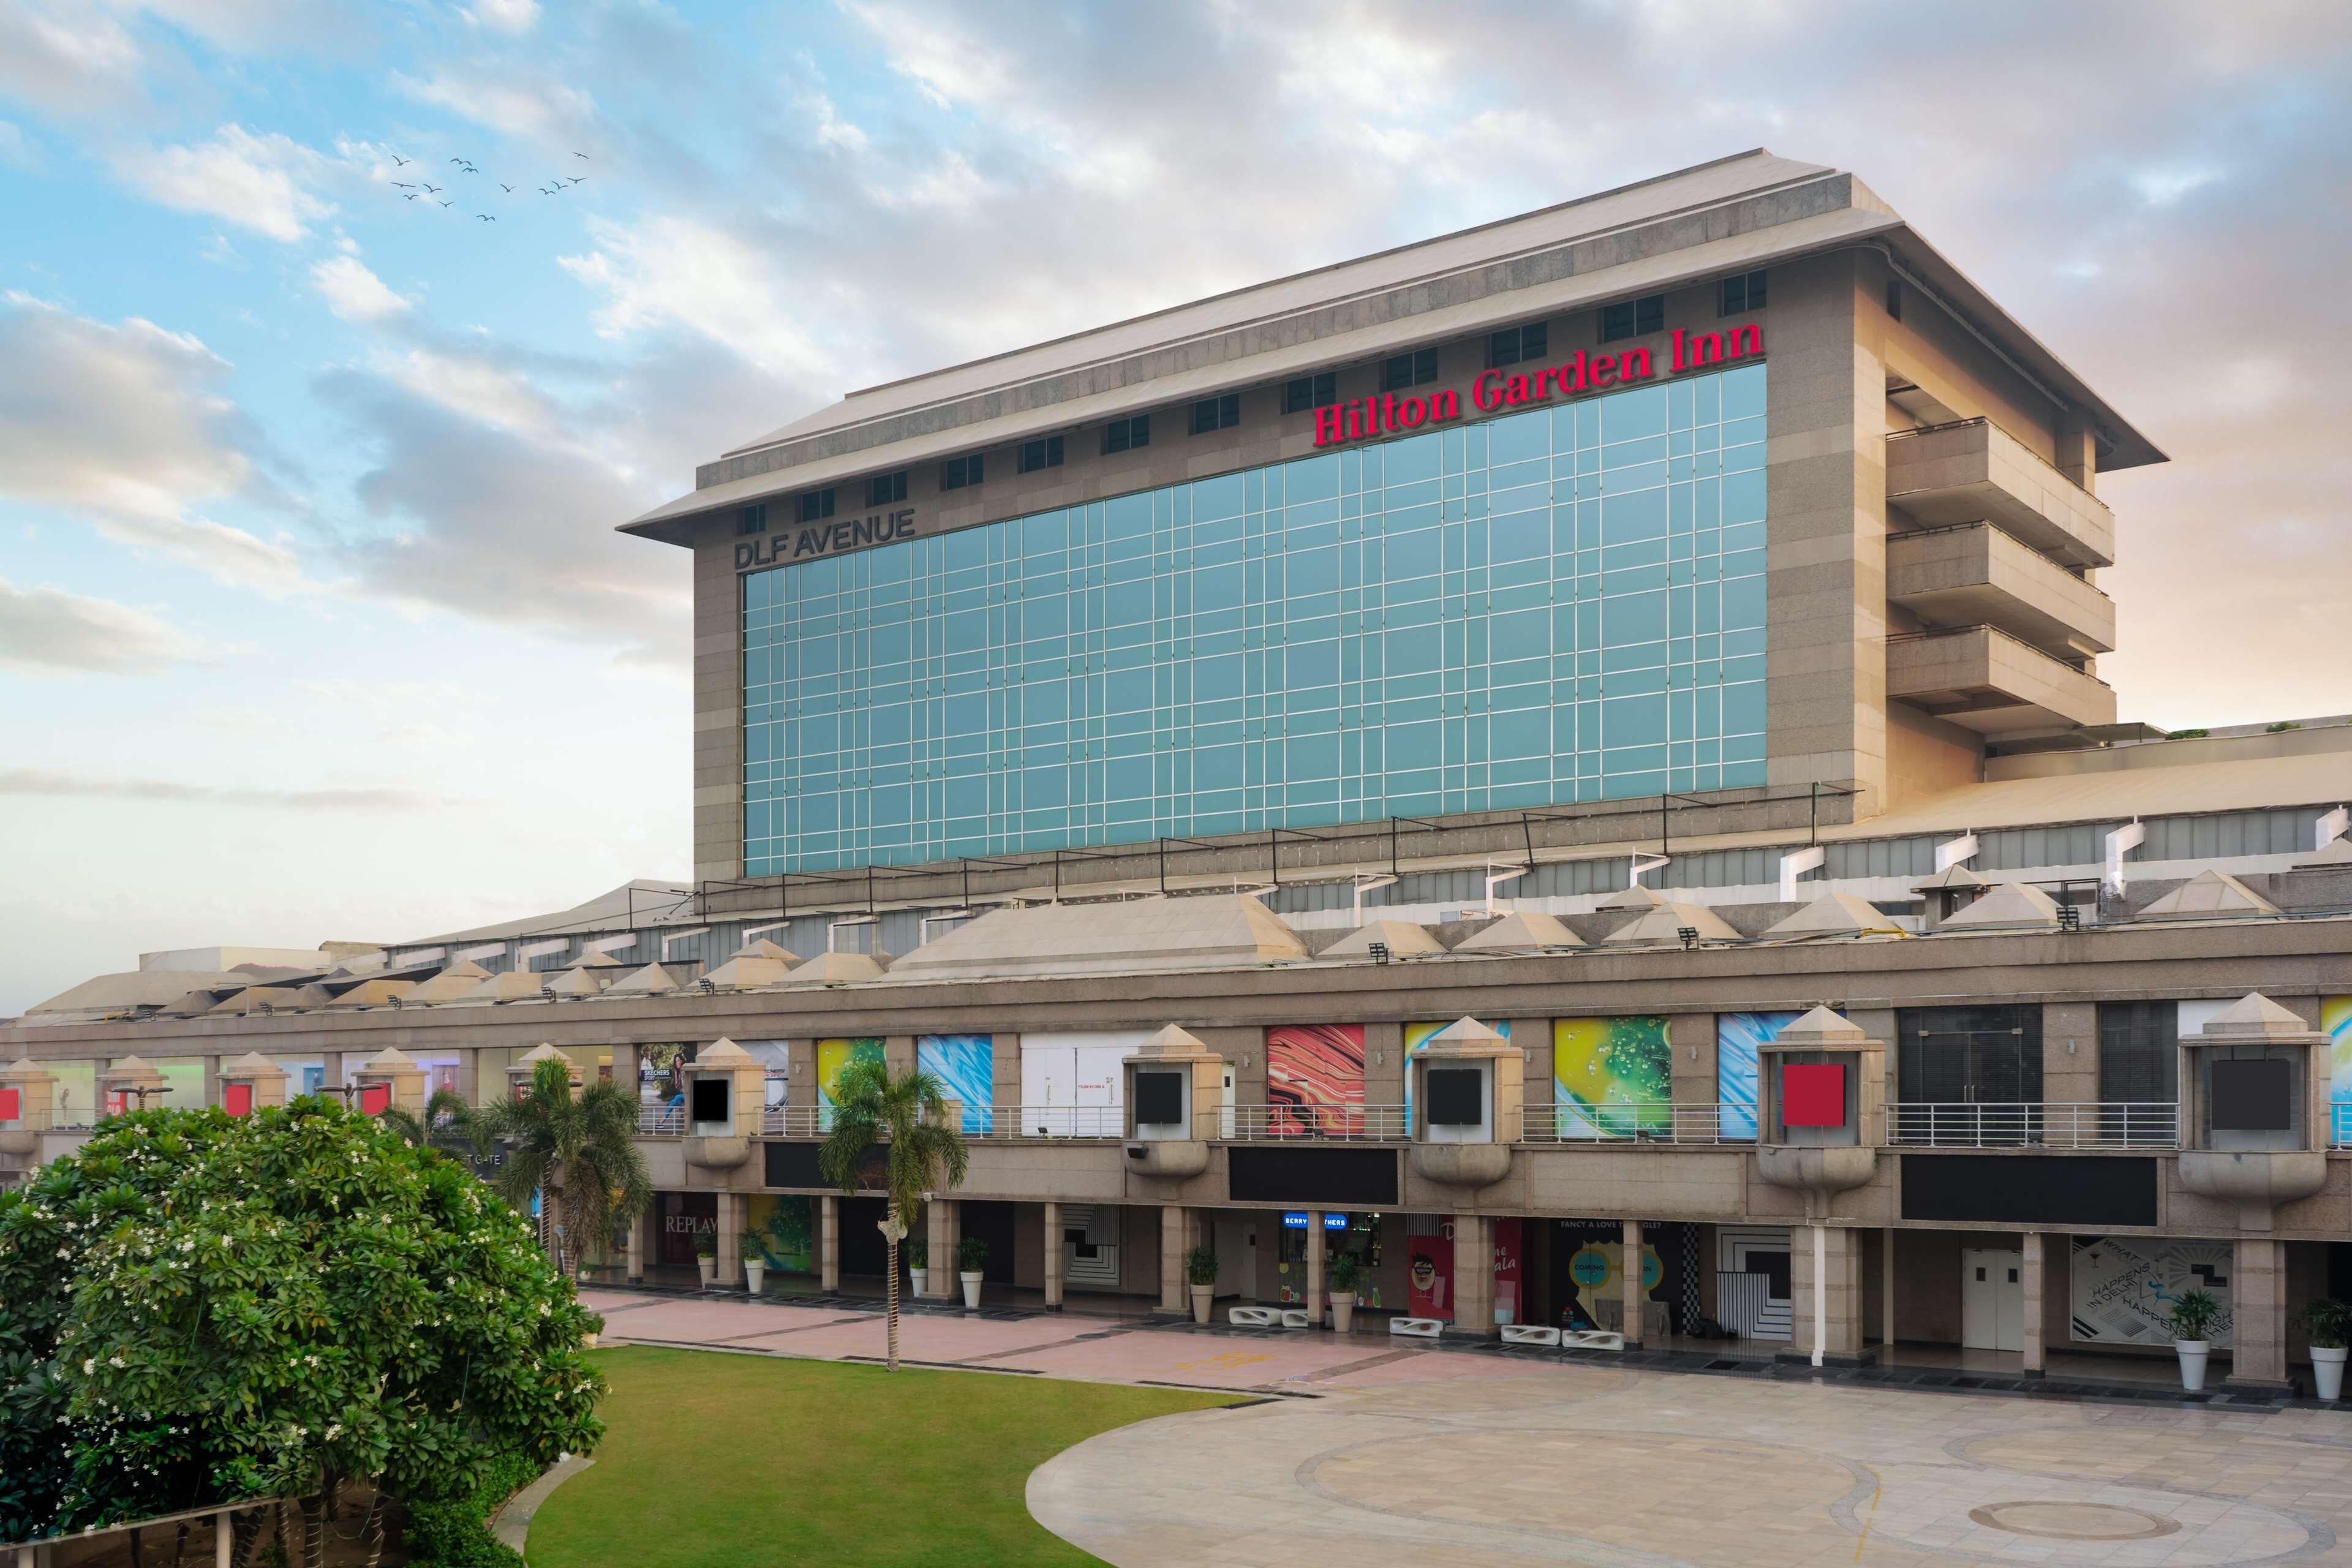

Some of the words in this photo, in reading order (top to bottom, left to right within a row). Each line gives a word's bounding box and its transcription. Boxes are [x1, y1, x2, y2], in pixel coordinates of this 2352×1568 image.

[1313, 388, 1460, 448] Hilton
[1472, 348, 1653, 412] Garden
[1668, 323, 1765, 374] Inn
[735, 533, 788, 570] DLF
[794, 508, 915, 557] AVENUE
[666, 1216, 718, 1234] REPLAY
[2104, 1238, 2141, 1262] WHAT
[2086, 1298, 2103, 1310] IN
[2101, 1278, 2138, 1301] DELHI
[2093, 1262, 2151, 1298] HAPPENS
